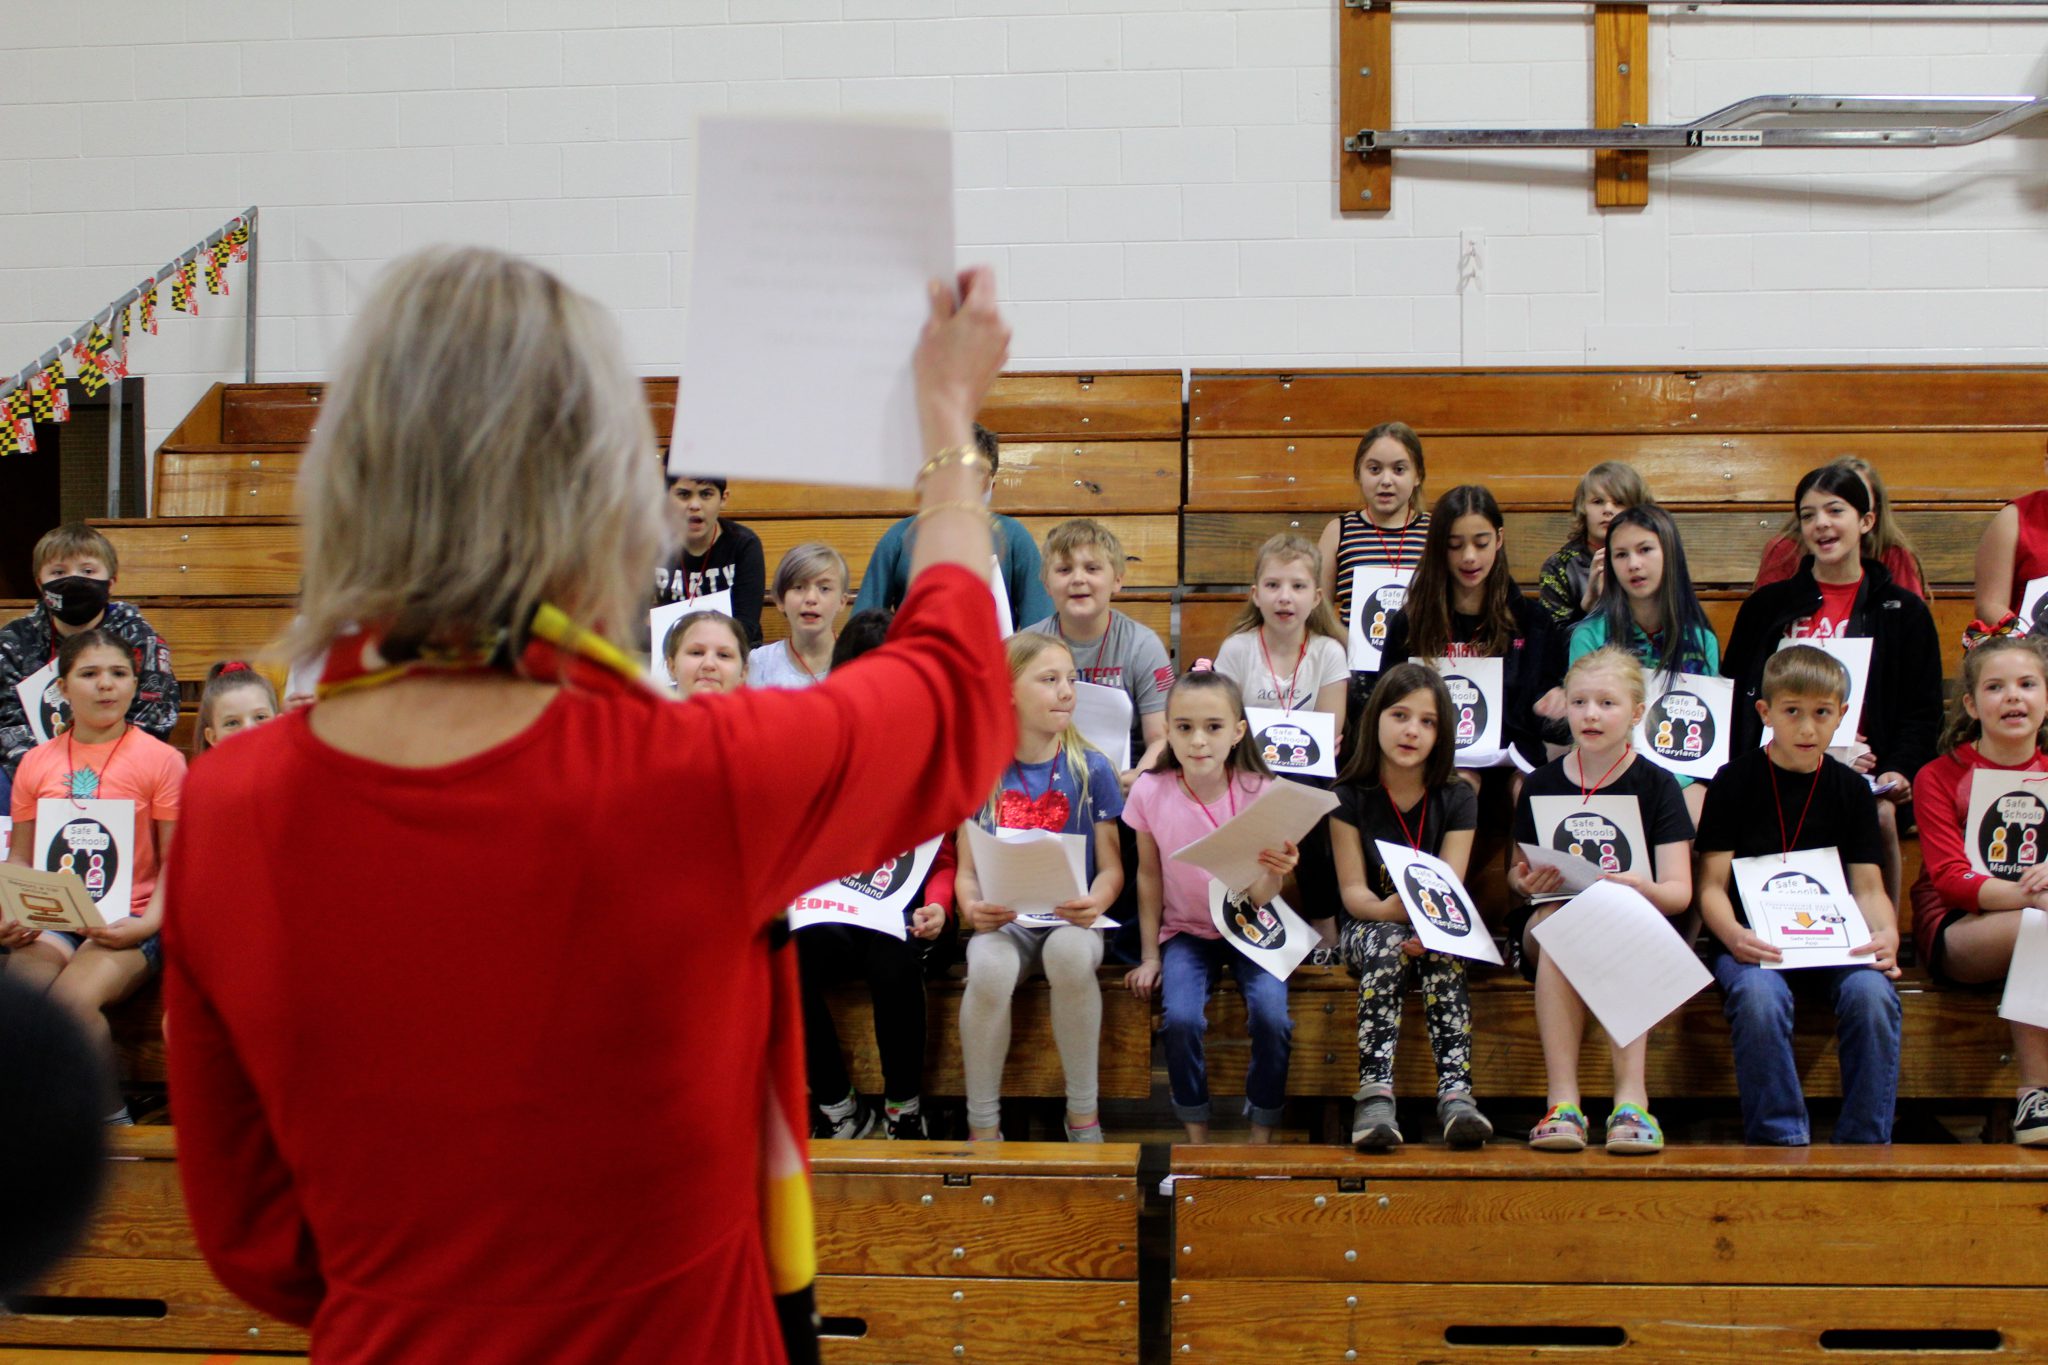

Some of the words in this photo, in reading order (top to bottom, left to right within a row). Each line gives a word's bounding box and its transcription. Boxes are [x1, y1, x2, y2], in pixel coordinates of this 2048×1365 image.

[655, 563, 736, 600] PARTY
[1382, 590, 1401, 598] Safe
[1446, 682, 1461, 690] afe
[1452, 691, 1477, 700] hools
[1669, 696, 1689, 706] Safe
[1668, 706, 1705, 718] Schools
[1656, 747, 1702, 758] Maryland
[2005, 799, 2027, 809] Safe
[2003, 809, 2043, 820] Schools
[1572, 819, 1594, 828] Safe
[71, 826, 91, 835] Safe
[1574, 828, 1614, 837] Schools
[70, 837, 107, 846] Schools
[1989, 862, 2022, 874] Maryla
[841, 875, 886, 899] Maryland
[1775, 879, 1799, 889] Safe
